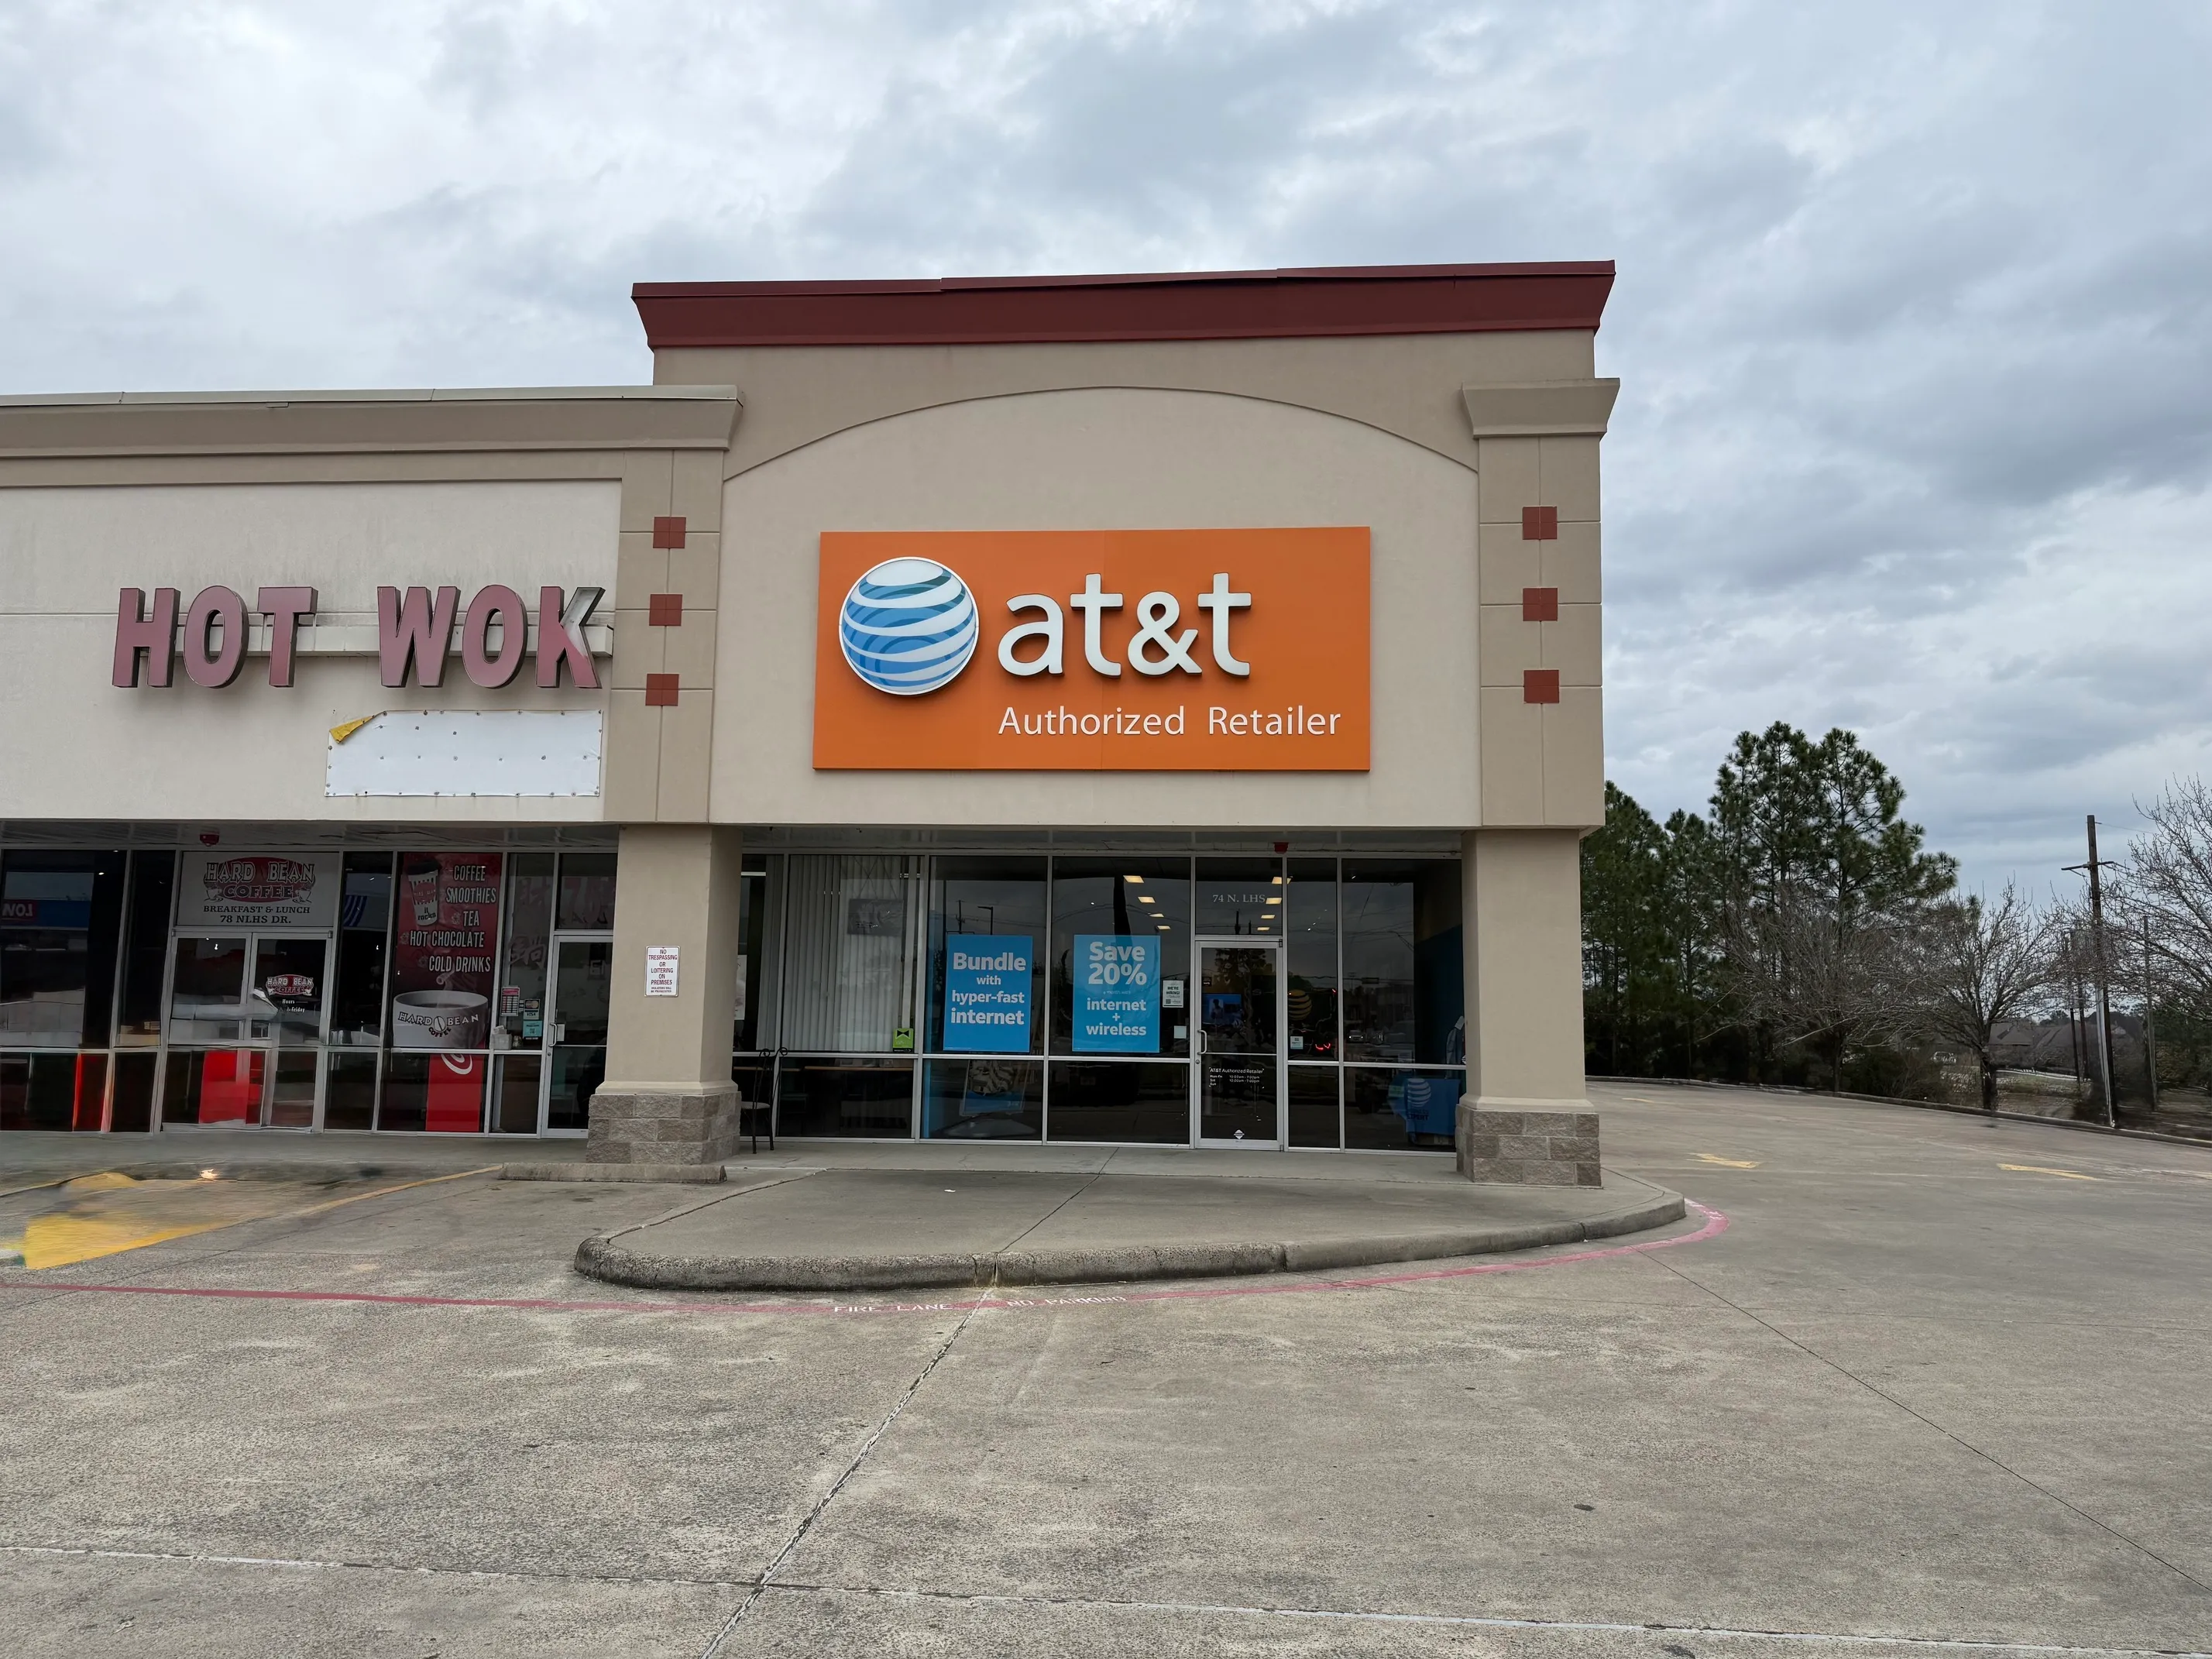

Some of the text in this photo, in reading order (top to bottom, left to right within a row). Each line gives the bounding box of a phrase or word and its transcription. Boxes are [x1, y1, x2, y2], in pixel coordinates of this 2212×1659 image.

[997, 572, 1252, 678] at&t
[112, 584, 606, 689] HOT WOK
[998, 706, 1341, 736] Authorized Retailer
[204, 860, 315, 884] HARD BEAN
[453, 864, 486, 881] COFFEE
[223, 884, 294, 898] COFFEE
[446, 887, 496, 904] SMOOTHIES
[1212, 894, 1266, 903] 74 N. LHS
[220, 915, 233, 923] 78
[272, 915, 291, 924] DR.
[463, 910, 480, 927] TEA
[410, 930, 485, 948] HOT CHOCOLATE
[1089, 941, 1146, 961] Save
[428, 956, 491, 973] COLD DRINKS
[953, 952, 1026, 971] Bundle
[266, 977, 314, 986] HARD BEAN
[976, 975, 1001, 985] with
[1088, 963, 1147, 985] 20%
[951, 990, 1025, 1005] hyper-fast
[1087, 998, 1146, 1011] internet
[398, 1012, 479, 1026] HARD BEAN
[950, 1007, 1025, 1025] internet
[1112, 1012, 1121, 1022] +
[428, 1027, 452, 1038] COFFEE
[1086, 1022, 1146, 1036] wireless
[1045, 1296, 1128, 1305] PARKING
